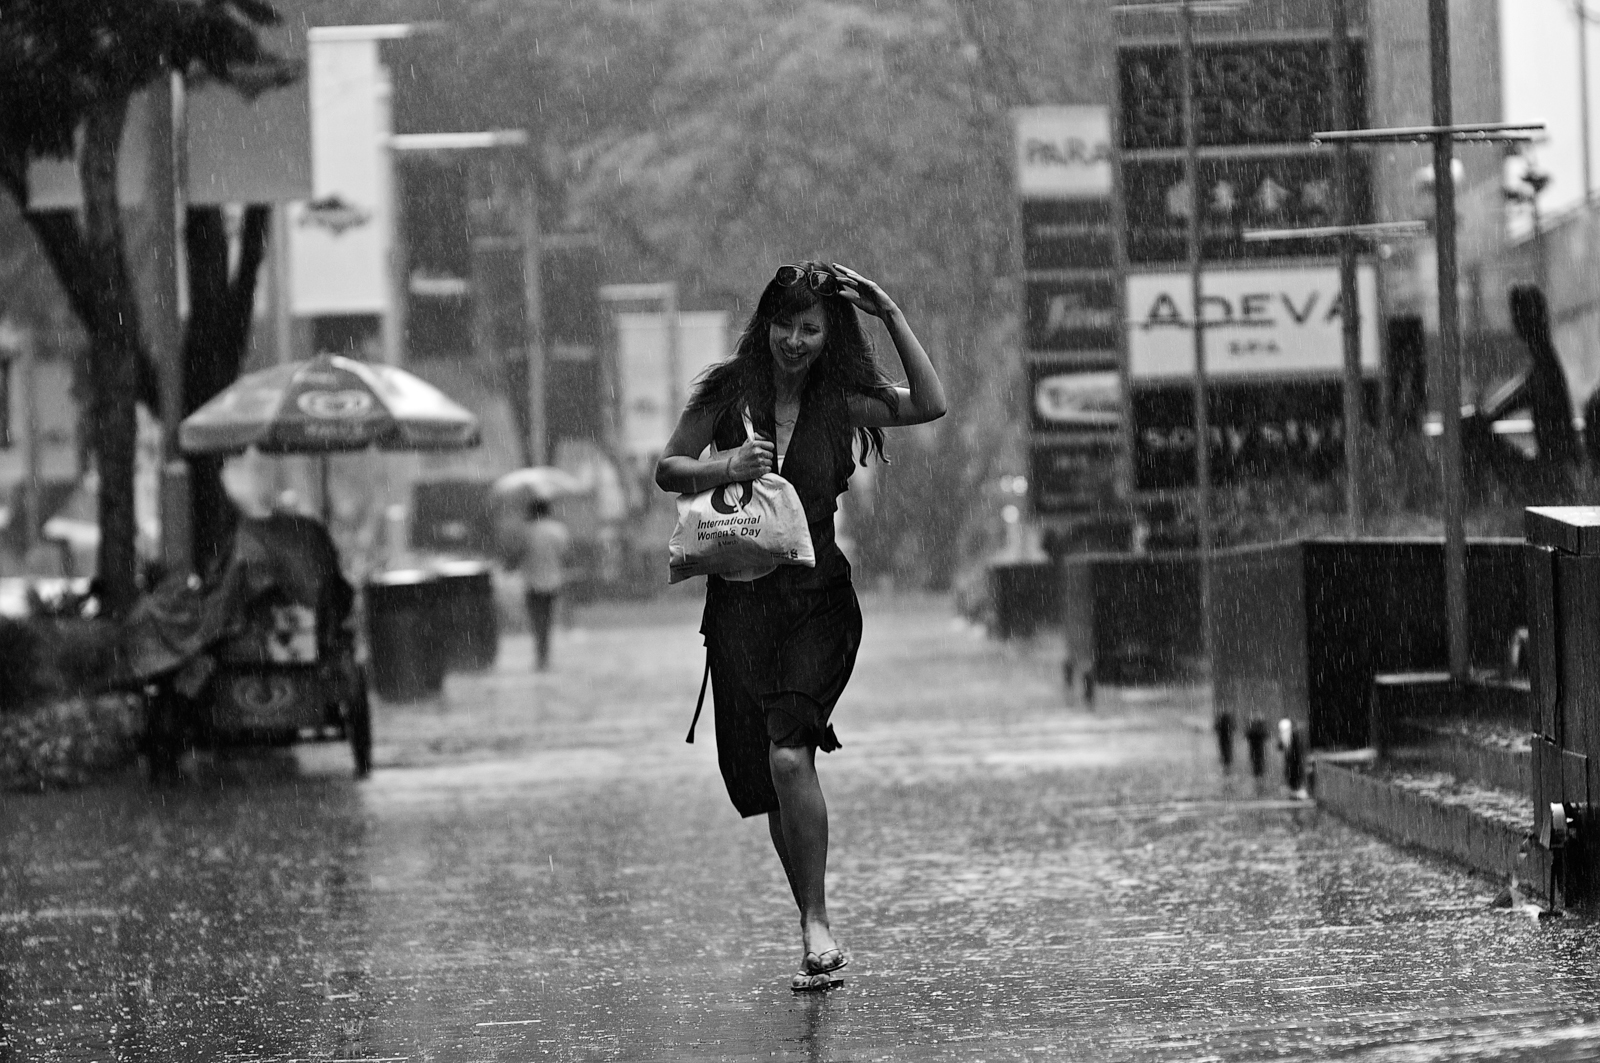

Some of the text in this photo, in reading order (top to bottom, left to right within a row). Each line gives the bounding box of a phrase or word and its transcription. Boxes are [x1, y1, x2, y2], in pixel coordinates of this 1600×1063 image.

[697, 515, 761, 529] International
[697, 527, 762, 541] Women's Day
